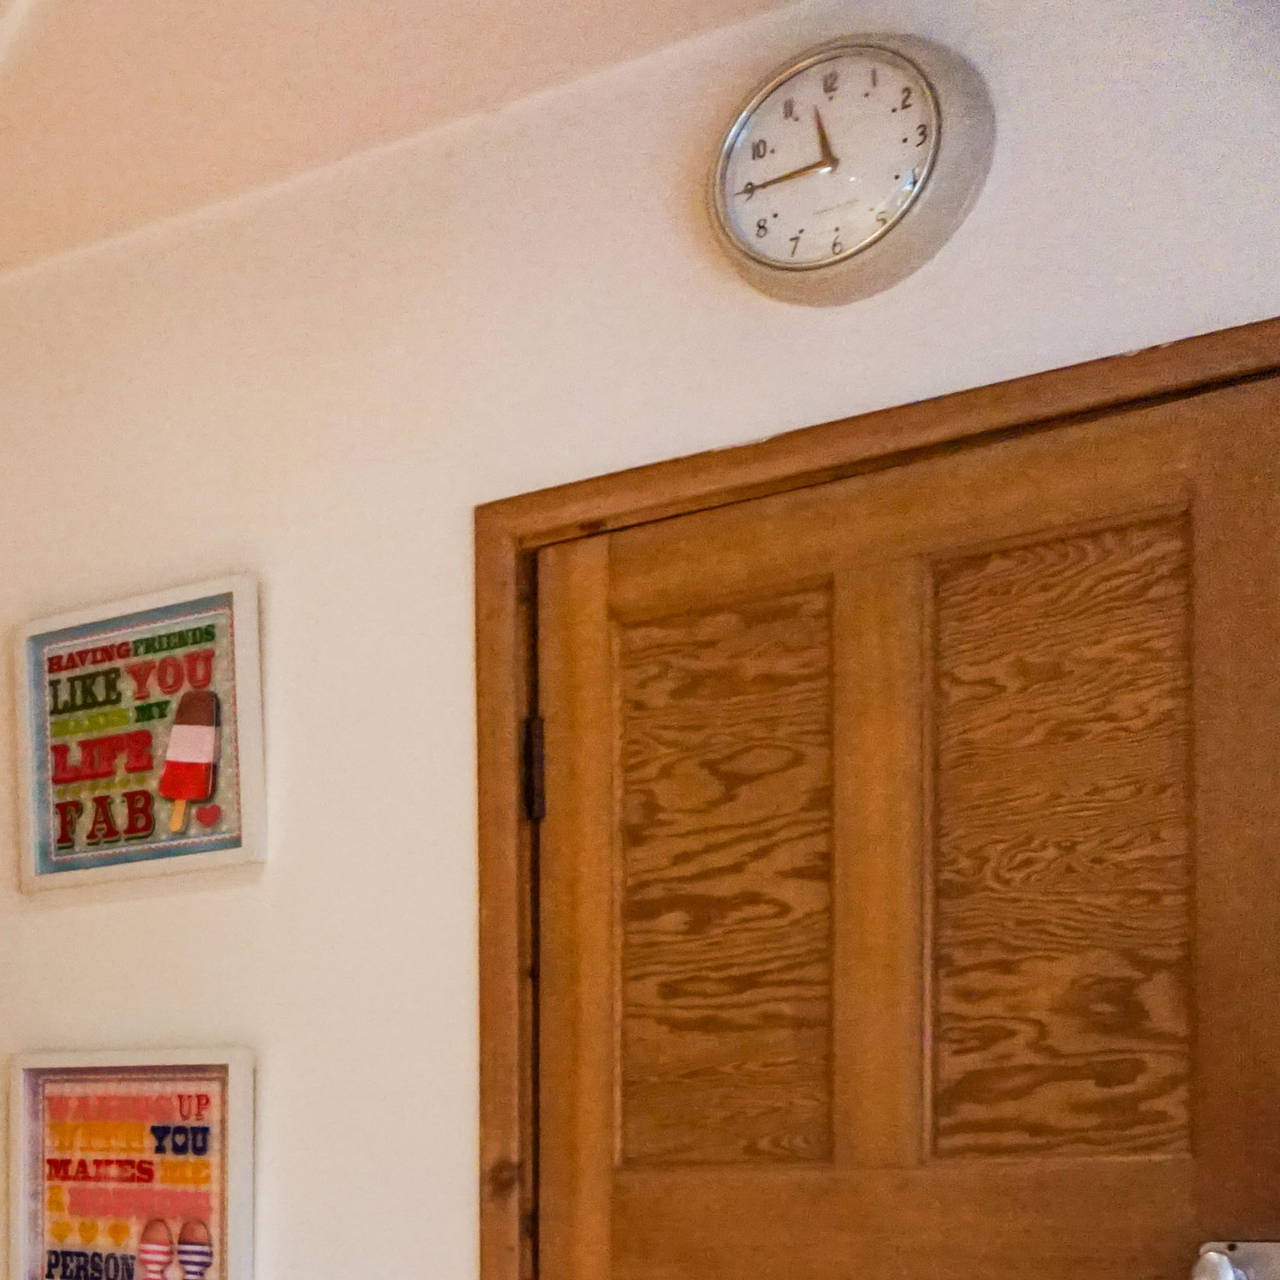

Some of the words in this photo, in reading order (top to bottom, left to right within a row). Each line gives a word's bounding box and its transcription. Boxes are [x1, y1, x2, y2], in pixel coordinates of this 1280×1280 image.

[900, 87, 912, 110] 2
[915, 124, 928, 147] 3
[752, 139, 767, 160] 10
[755, 218, 768, 238] 8
[789, 236, 801, 257] 7
[832, 235, 842, 255] 6
[47, 641, 131, 674] HAVING
[132, 624, 216, 656] FRIENDS
[48, 667, 122, 715] LIKE
[126, 649, 216, 700] YOU
[51, 729, 154, 785] LIFE
[55, 789, 157, 850] FAB
[177, 1094, 210, 1121] UP
[150, 1125, 210, 1156] YOU
[46, 1158, 155, 1183] MAKES
